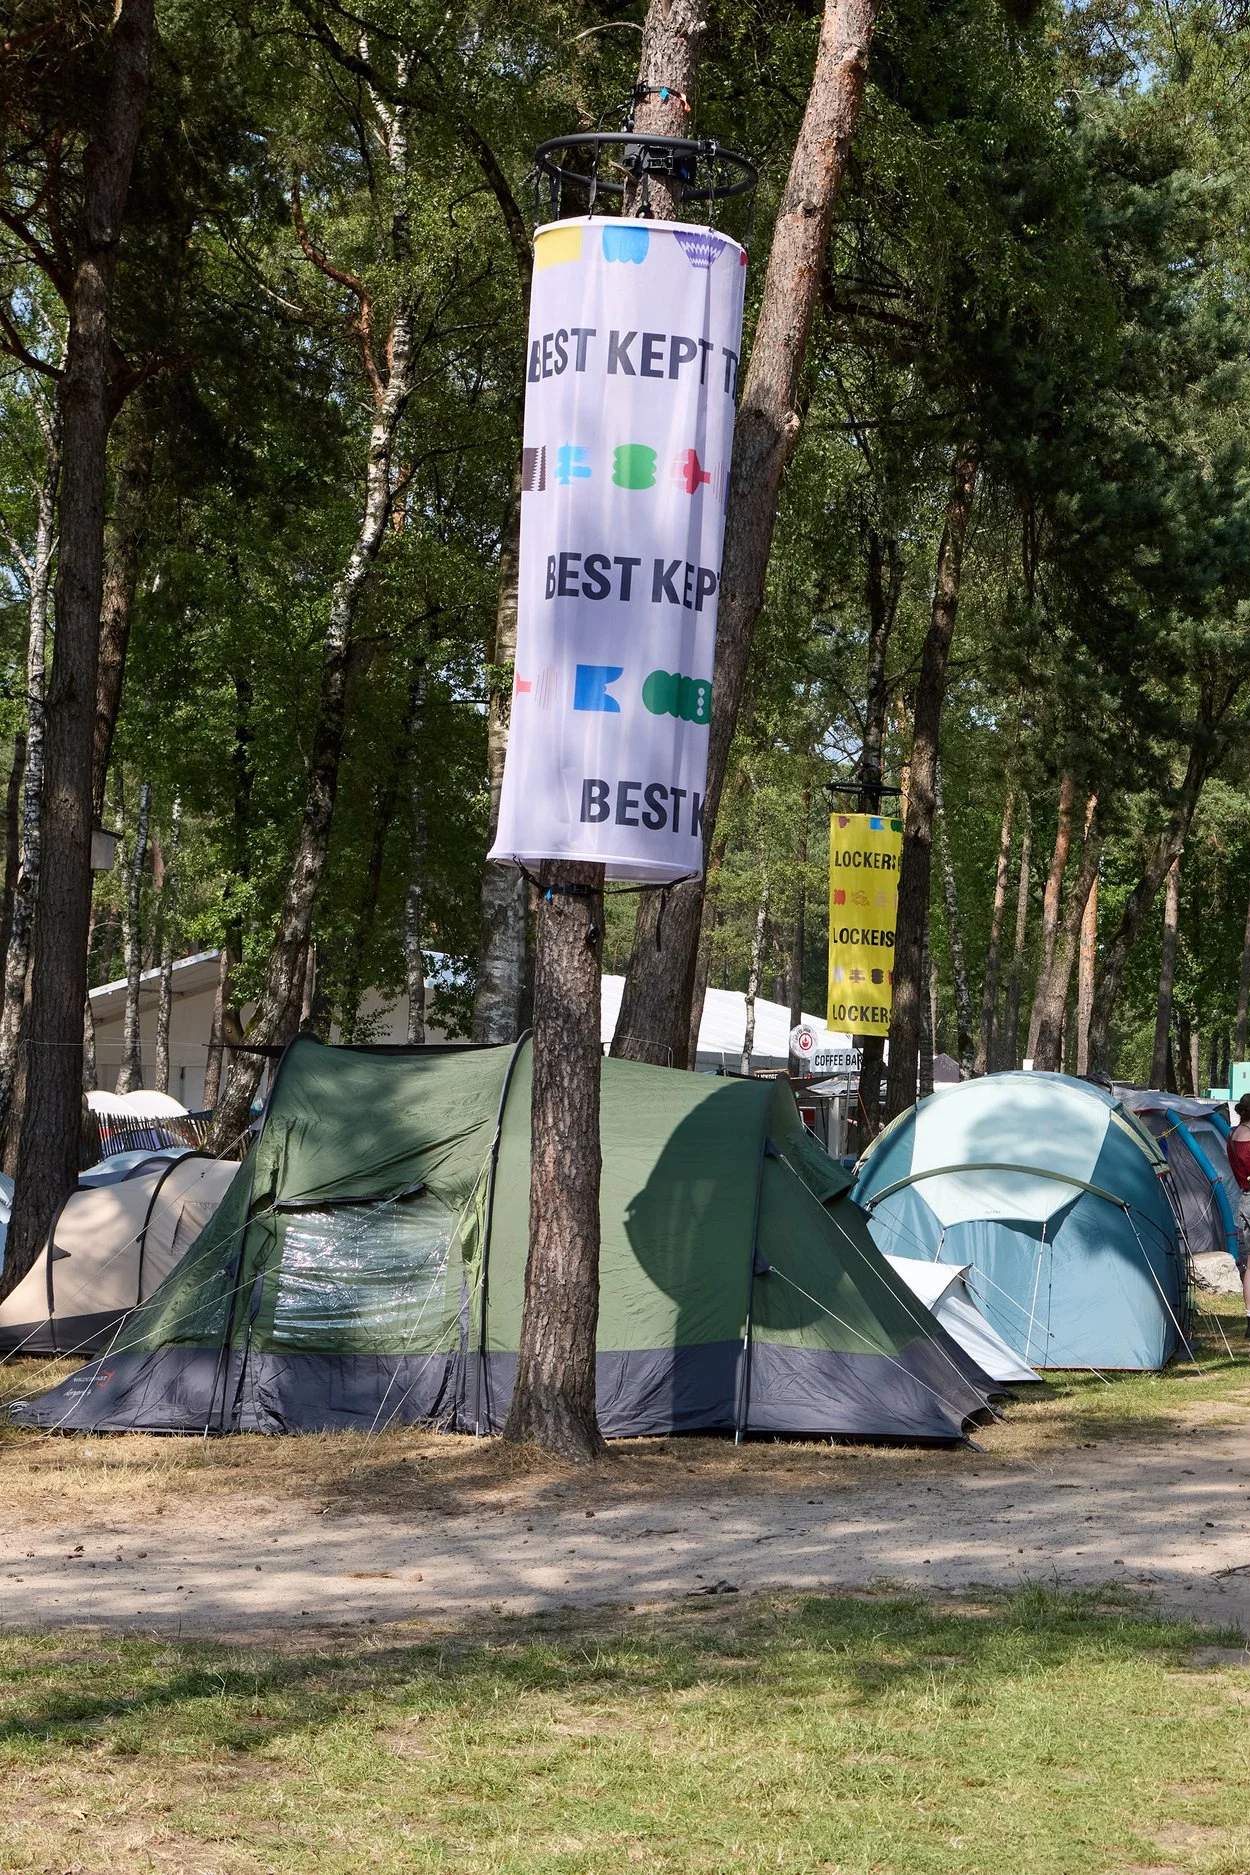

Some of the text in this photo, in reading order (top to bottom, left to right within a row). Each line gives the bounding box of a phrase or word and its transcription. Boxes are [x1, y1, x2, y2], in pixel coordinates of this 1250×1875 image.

[528, 328, 596, 382] BEST
[607, 330, 713, 385] KEPT
[545, 552, 719, 613] BEST KEP
[580, 779, 686, 833] BEST
[815, 1054, 843, 1066] COFFEE
